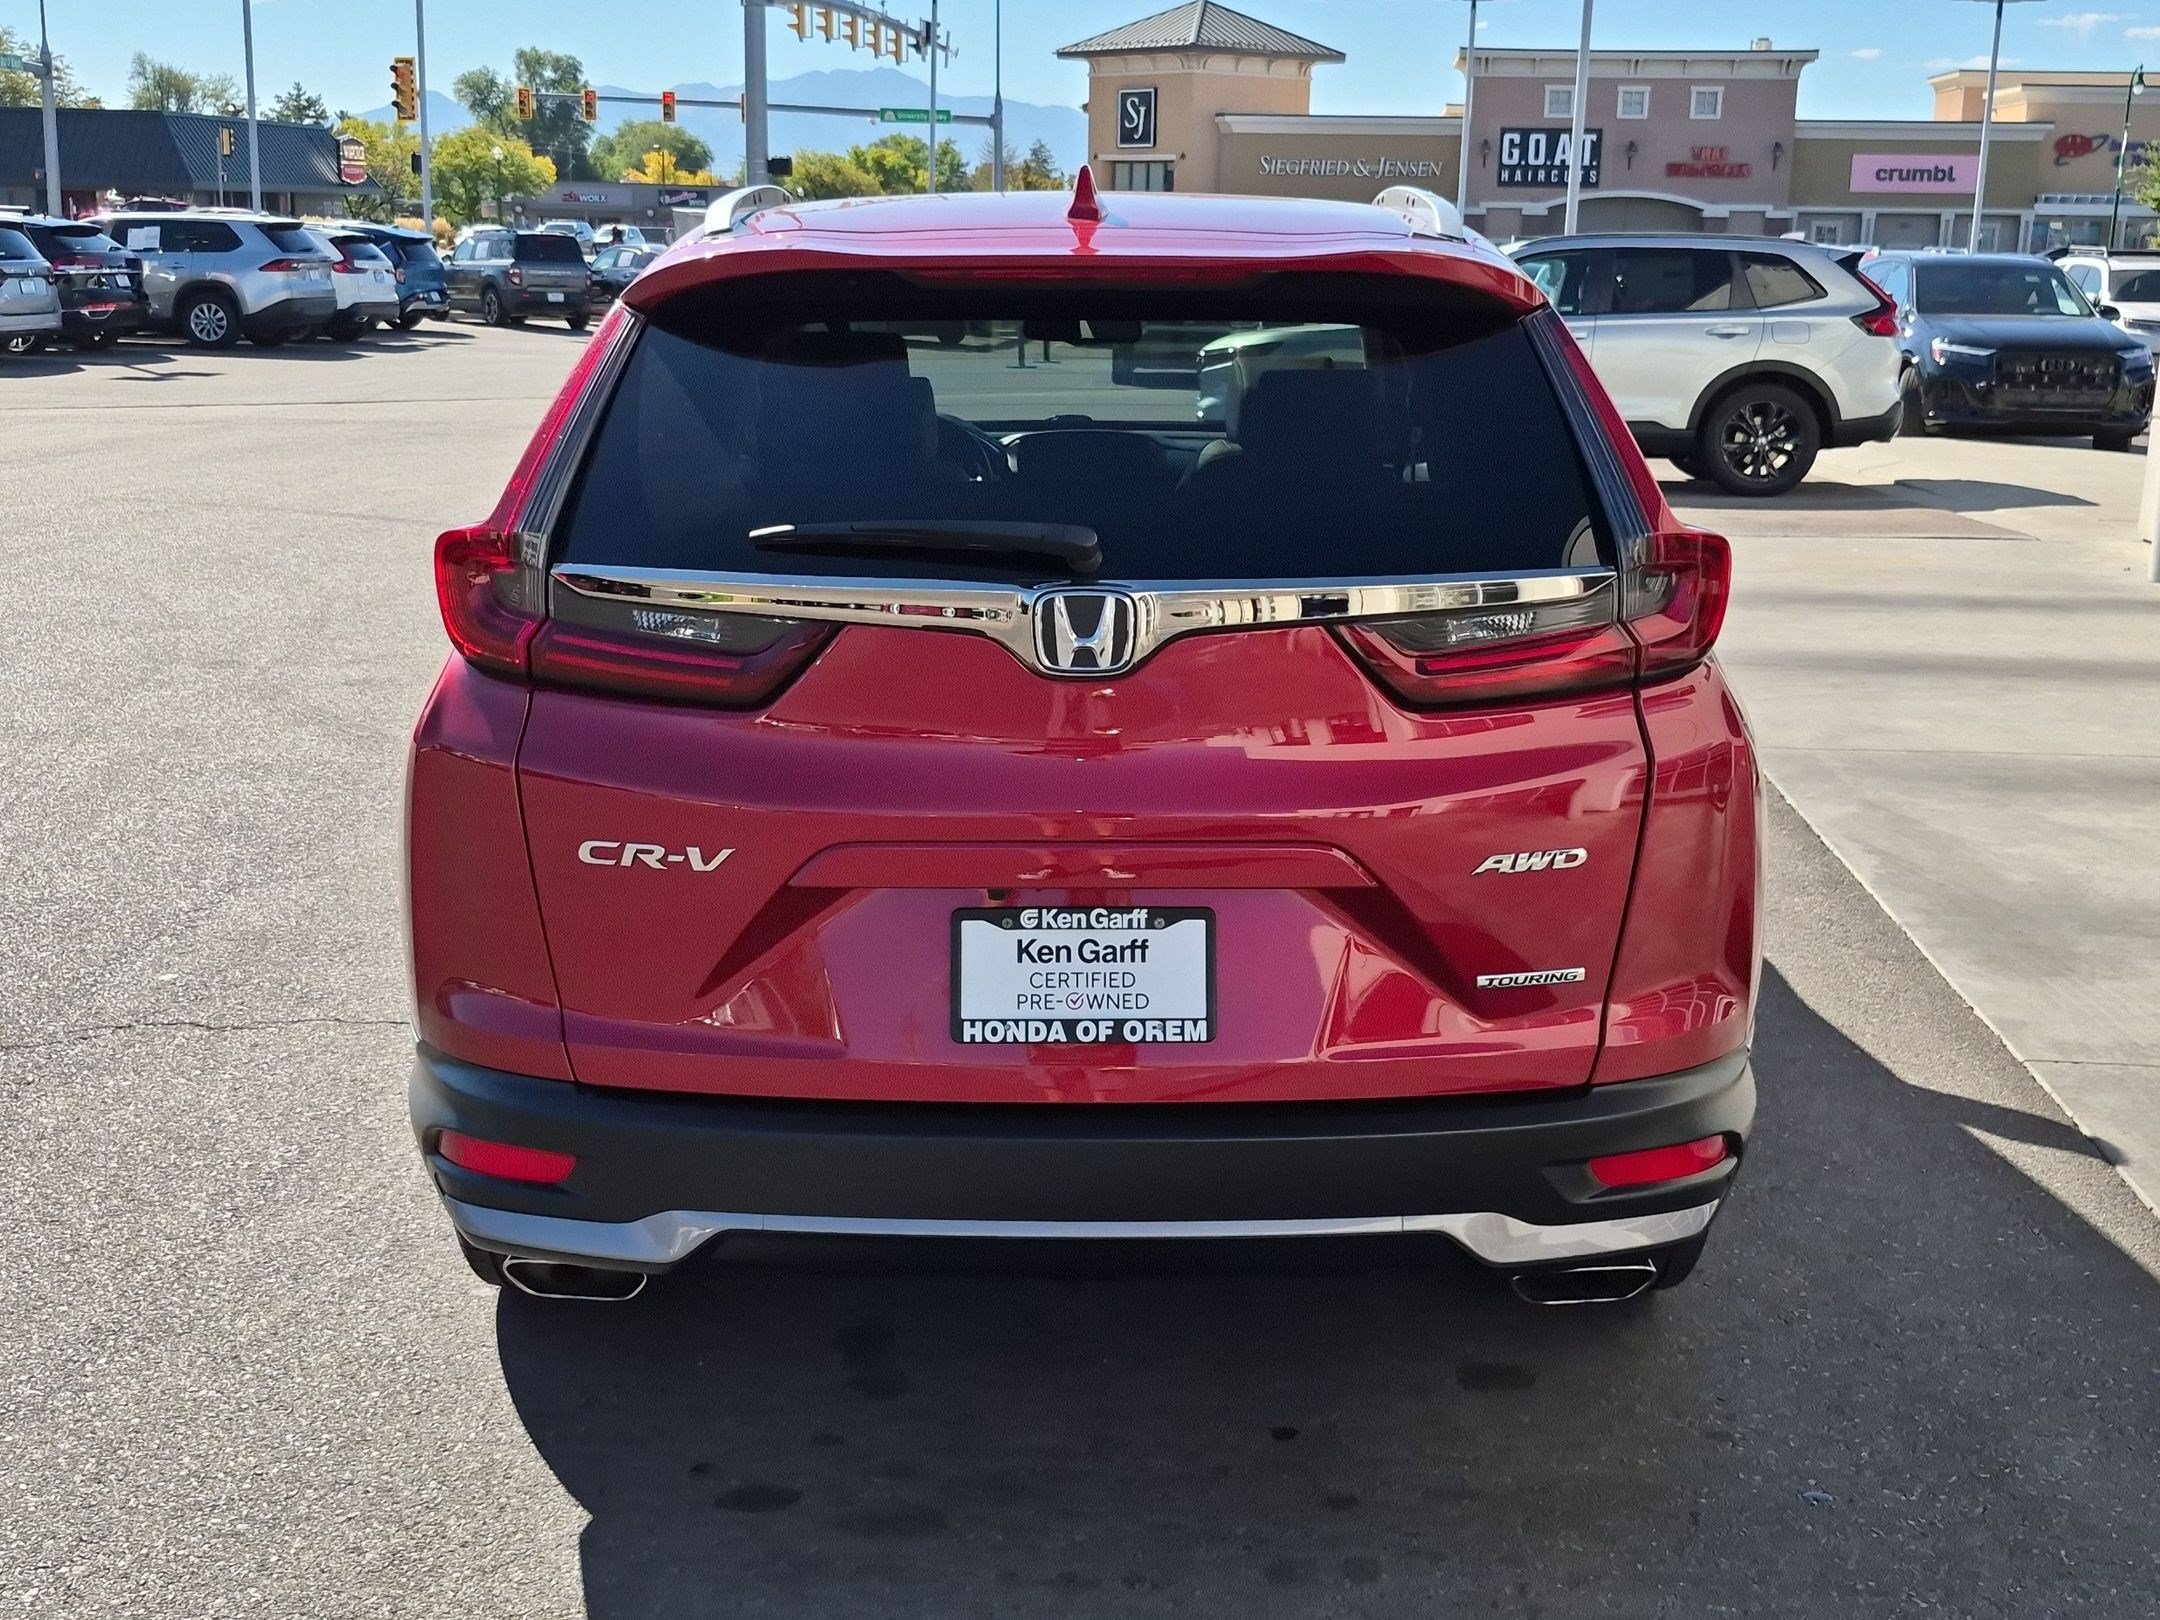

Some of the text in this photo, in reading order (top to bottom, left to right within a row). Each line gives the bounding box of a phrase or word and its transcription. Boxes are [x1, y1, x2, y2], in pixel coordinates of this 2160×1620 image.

[1124, 97, 1146, 139] SJ
[1501, 133, 1598, 166] G.O.AT.
[1258, 155, 1443, 179] SIEGFRIED & JENSEN
[1875, 165, 1956, 182] crumbl
[577, 840, 737, 872] CR-V
[1471, 847, 1588, 876] AWD
[1041, 908, 1149, 929] Ken Garff
[1016, 938, 1149, 964] Ken Garff
[1029, 971, 1136, 989] CERTIFIED
[1484, 971, 1579, 987] TOURING
[962, 1019, 1207, 1043] HONDA OF OREM
